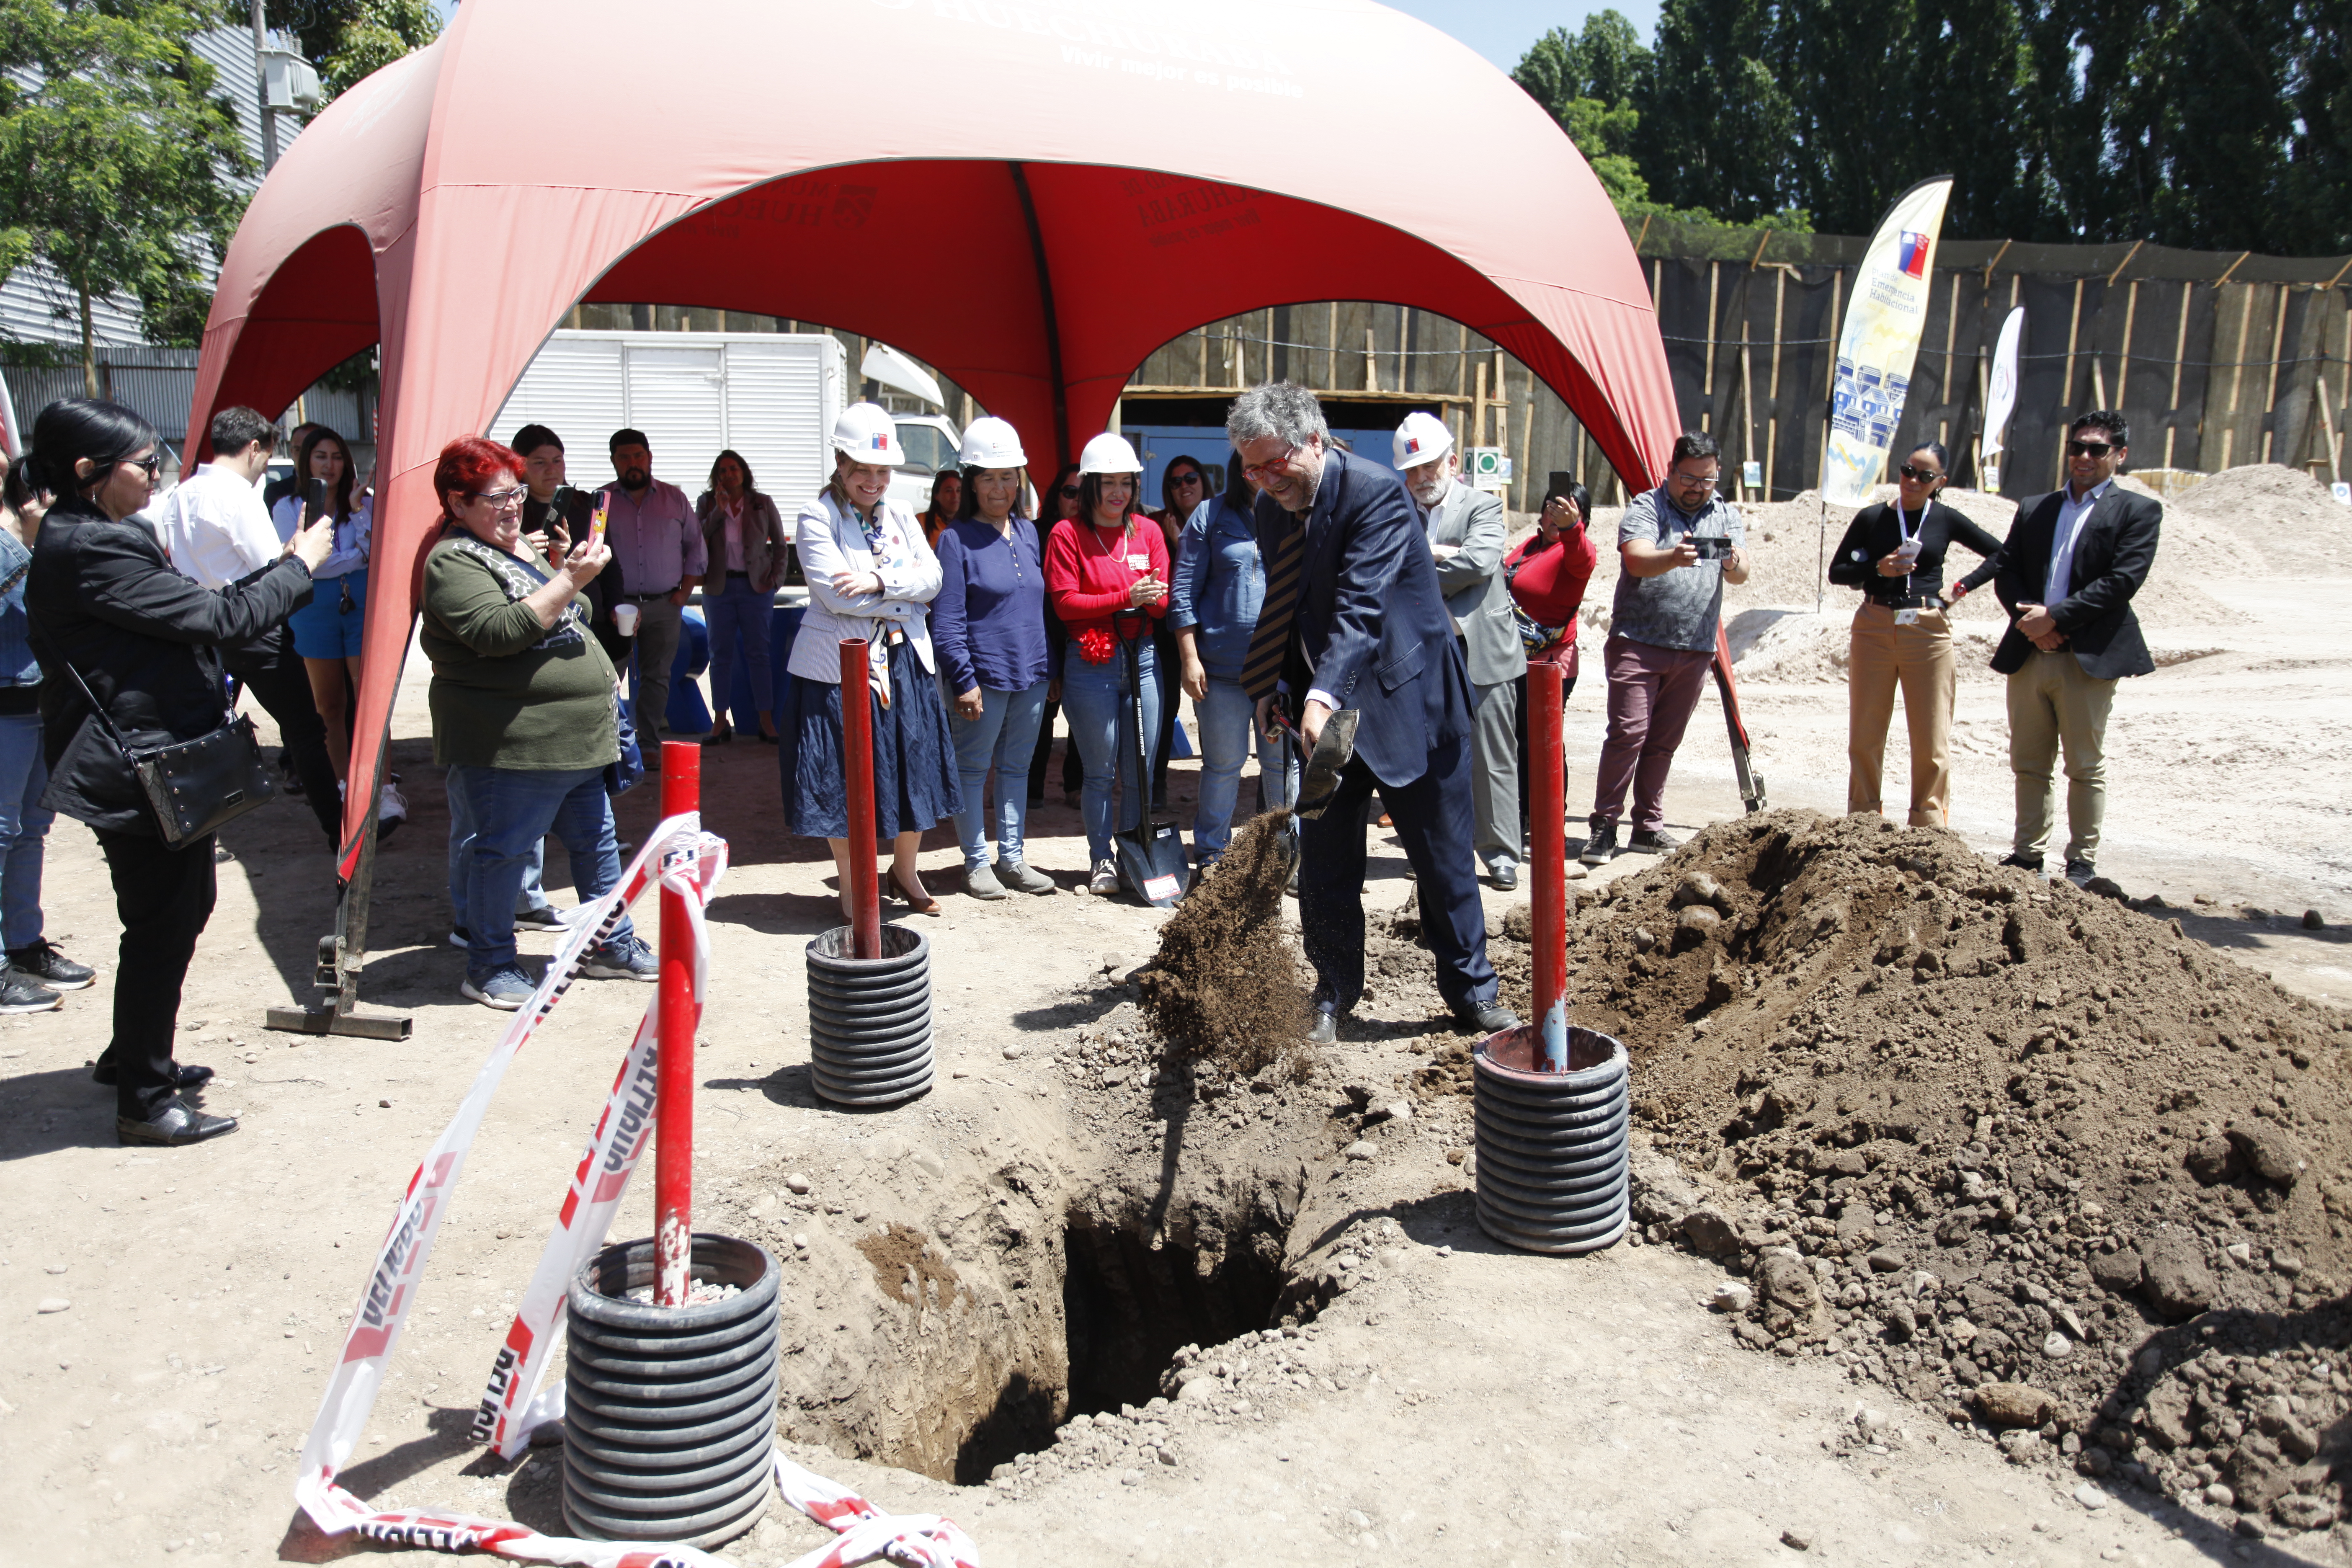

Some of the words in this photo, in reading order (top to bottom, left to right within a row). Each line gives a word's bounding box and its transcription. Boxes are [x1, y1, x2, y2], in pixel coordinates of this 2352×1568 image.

[1060, 44, 1114, 69] Vivir
[1121, 58, 1188, 81] mejor
[1194, 70, 1220, 86] es
[1226, 74, 1304, 99] posible
[1872, 268, 1890, 279] Plan
[1890, 274, 1899, 283] de
[1869, 289, 1919, 315] Habitacional
[1871, 277, 1915, 302] Emergencia
